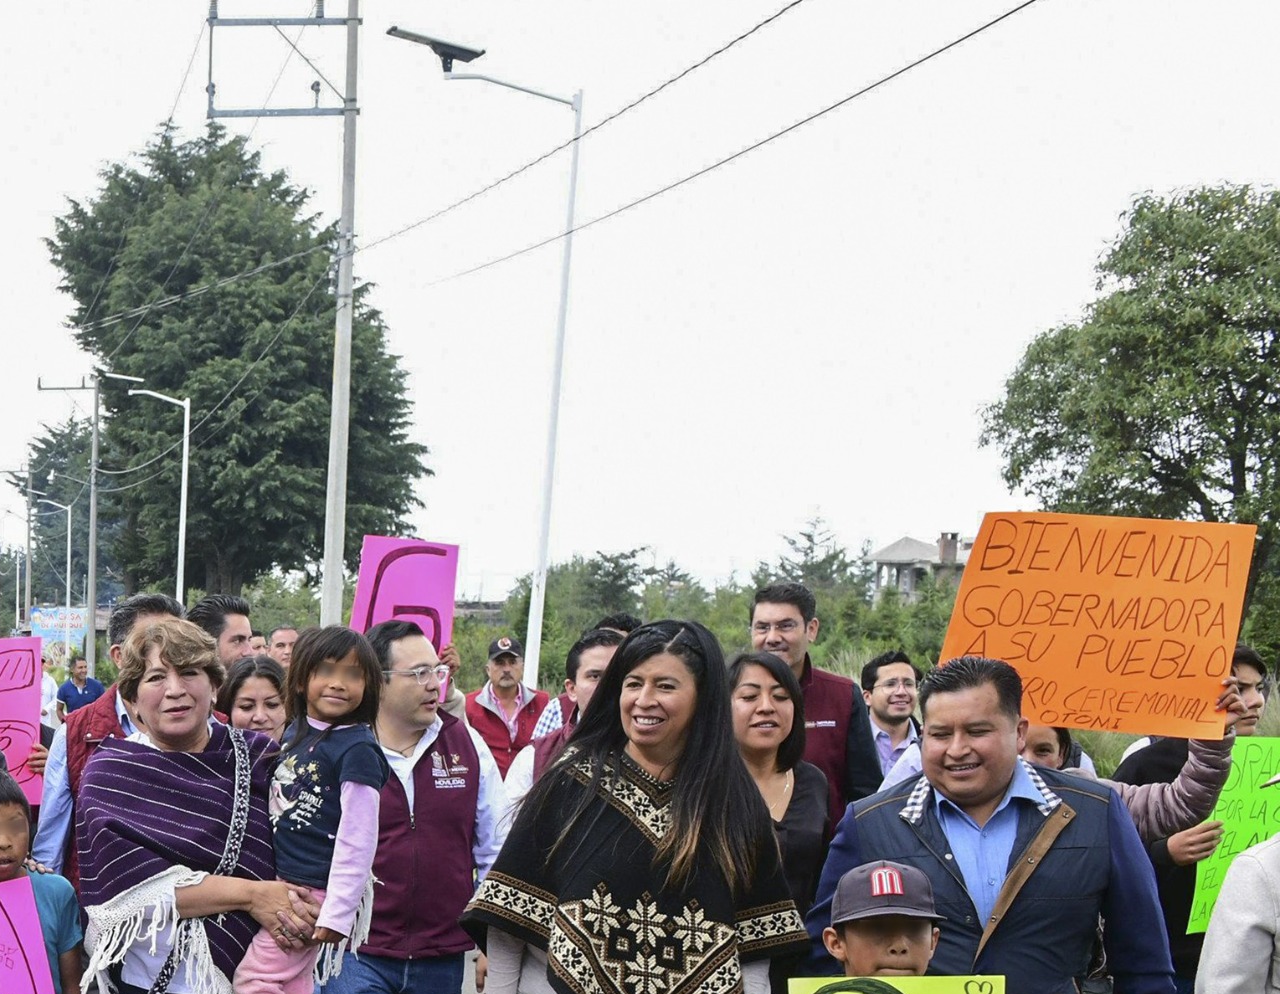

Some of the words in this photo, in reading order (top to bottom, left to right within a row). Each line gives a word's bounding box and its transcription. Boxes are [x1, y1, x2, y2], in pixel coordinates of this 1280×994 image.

[979, 518, 1231, 588] BIENVENIDA
[962, 584, 1226, 640] GOBERNADORA
[963, 629, 987, 658] A
[1000, 630, 1056, 663] SU
[1076, 633, 1227, 680] PUEBLO
[1021, 676, 1058, 710] RO
[1062, 685, 1219, 724] CEREMONIAL
[1039, 709, 1123, 730] OTOMI
[1249, 799, 1268, 826] LA
